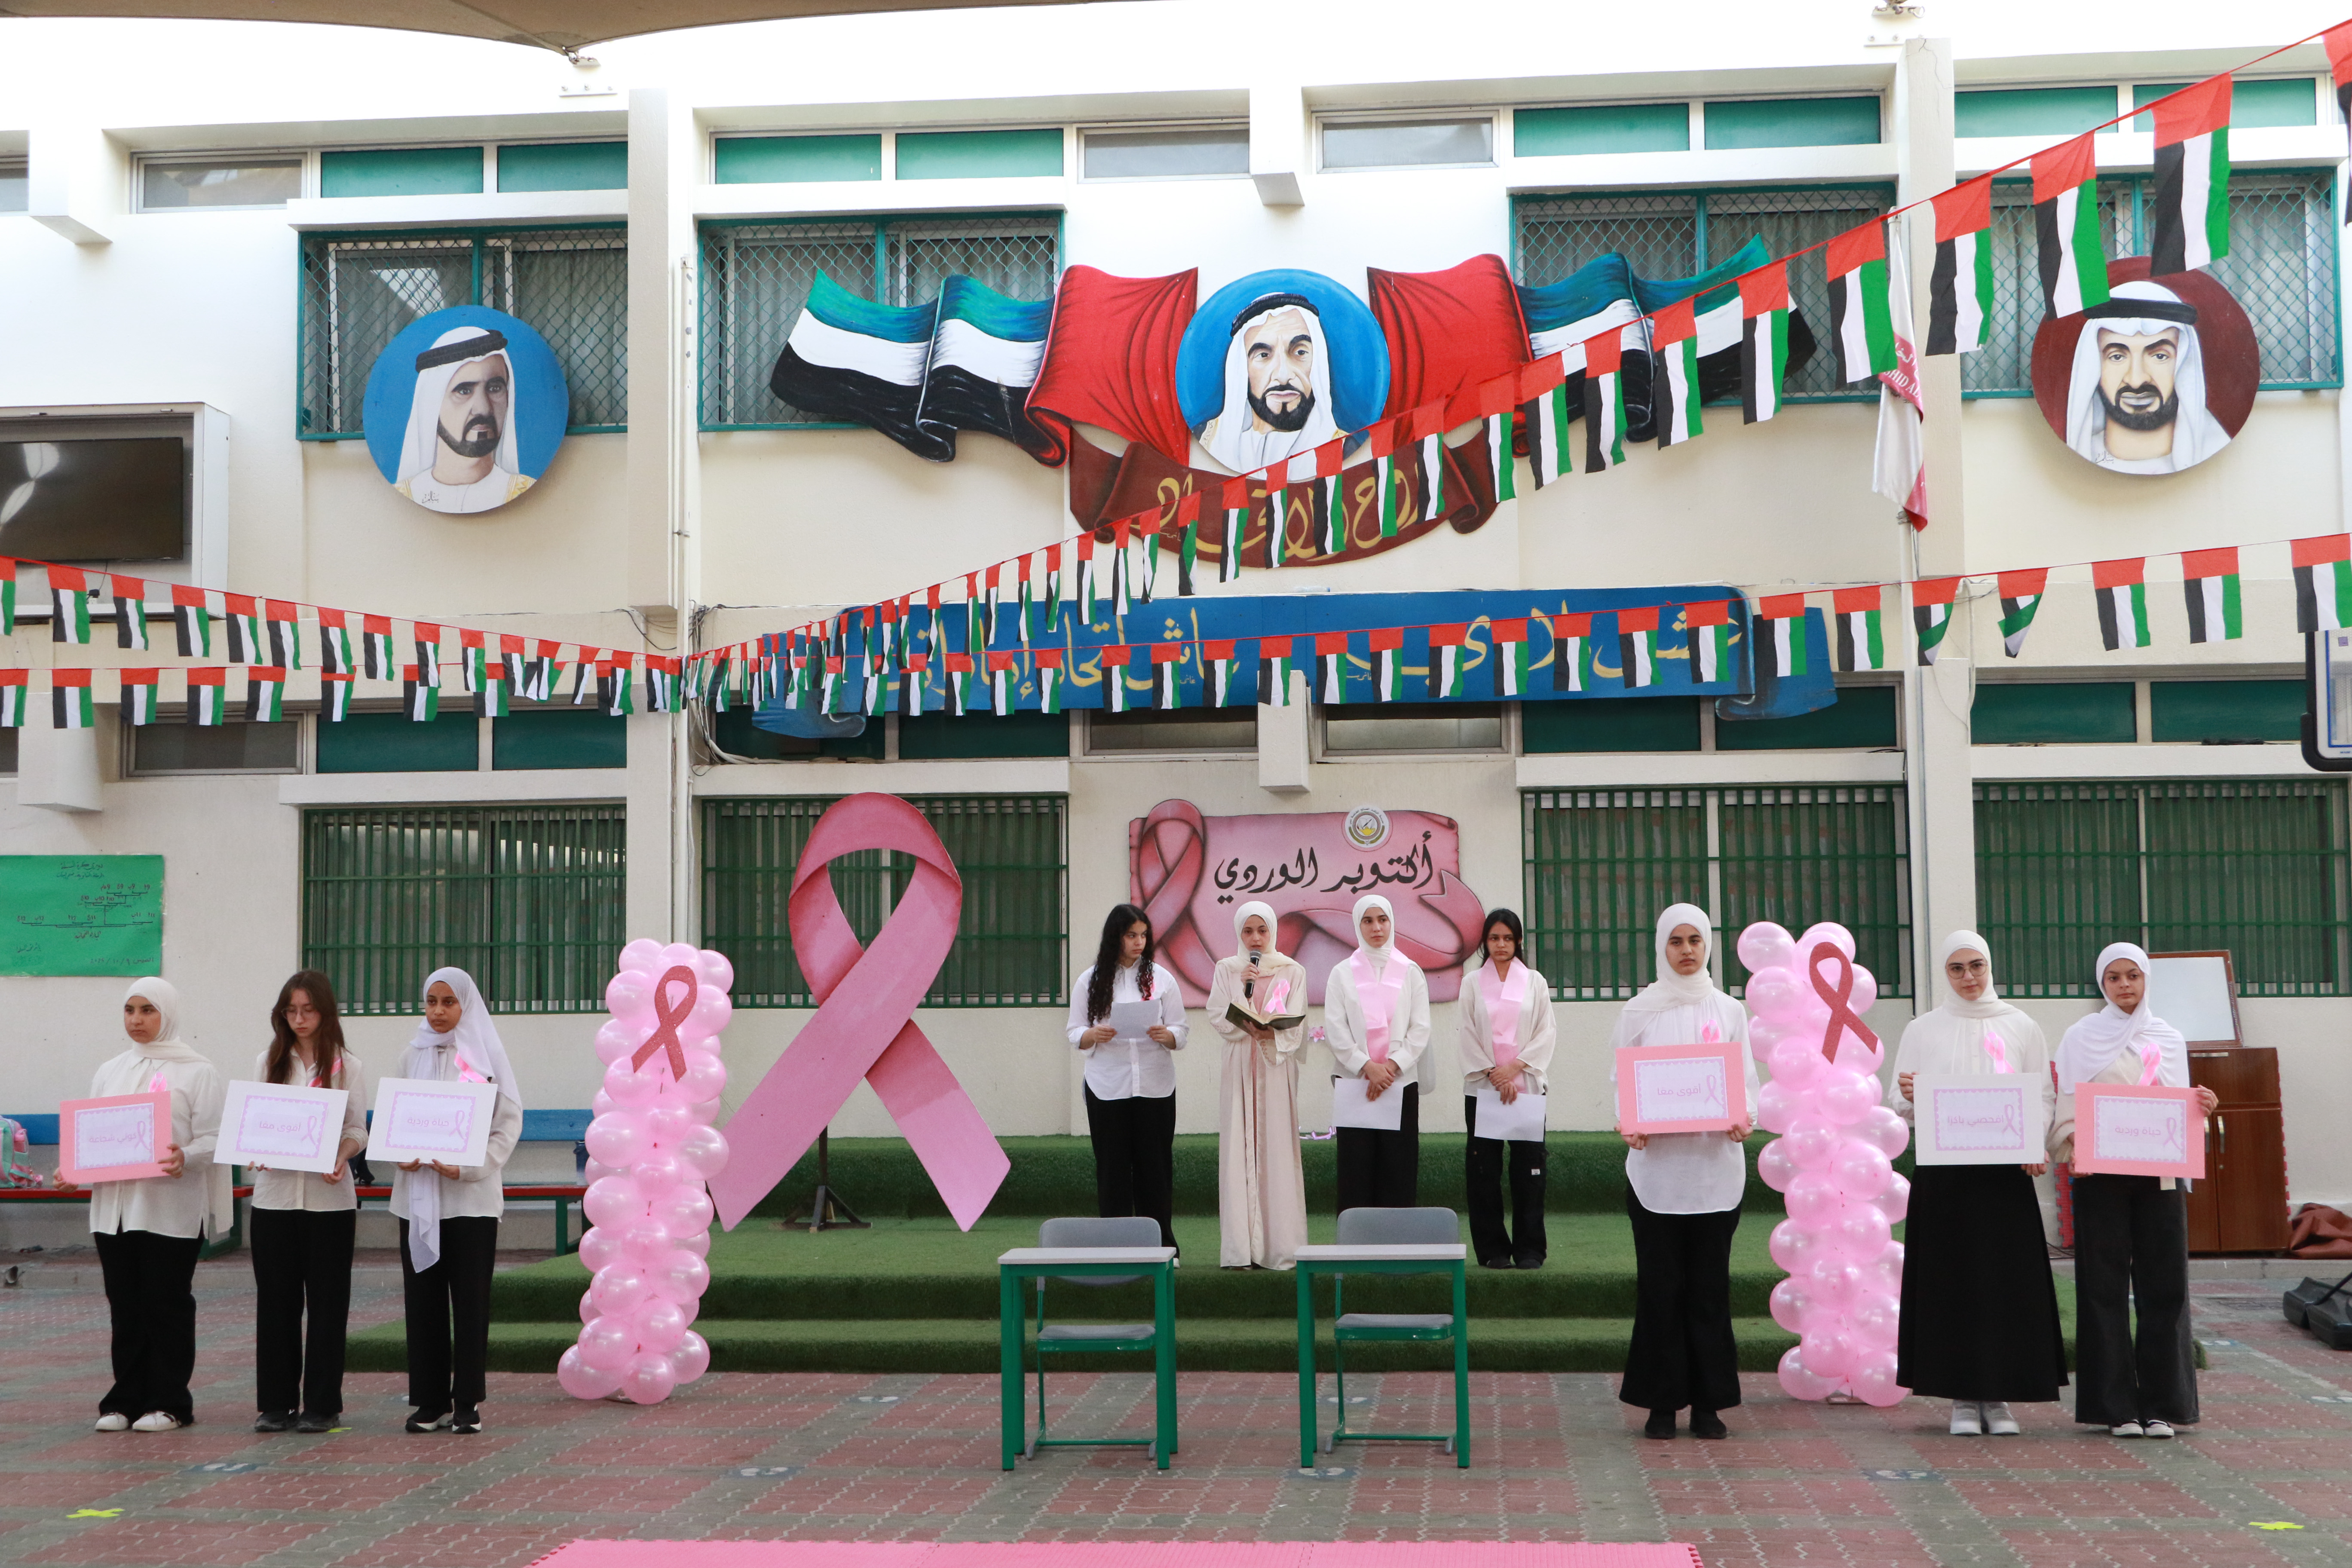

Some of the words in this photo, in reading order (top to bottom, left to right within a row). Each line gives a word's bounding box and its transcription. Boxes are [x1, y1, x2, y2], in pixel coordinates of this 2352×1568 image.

[1320, 830, 1433, 894] أكتوبر
[1214, 846, 1319, 904] الوردي
[1677, 1083, 1701, 1096] أقوى
[277, 1122, 301, 1133] أقوى
[407, 1117, 429, 1127] وردية
[432, 1118, 449, 1127] حياة
[2115, 1125, 2139, 1136] وردية
[2142, 1127, 2161, 1136] حياة
[117, 1132, 136, 1144] كوني
